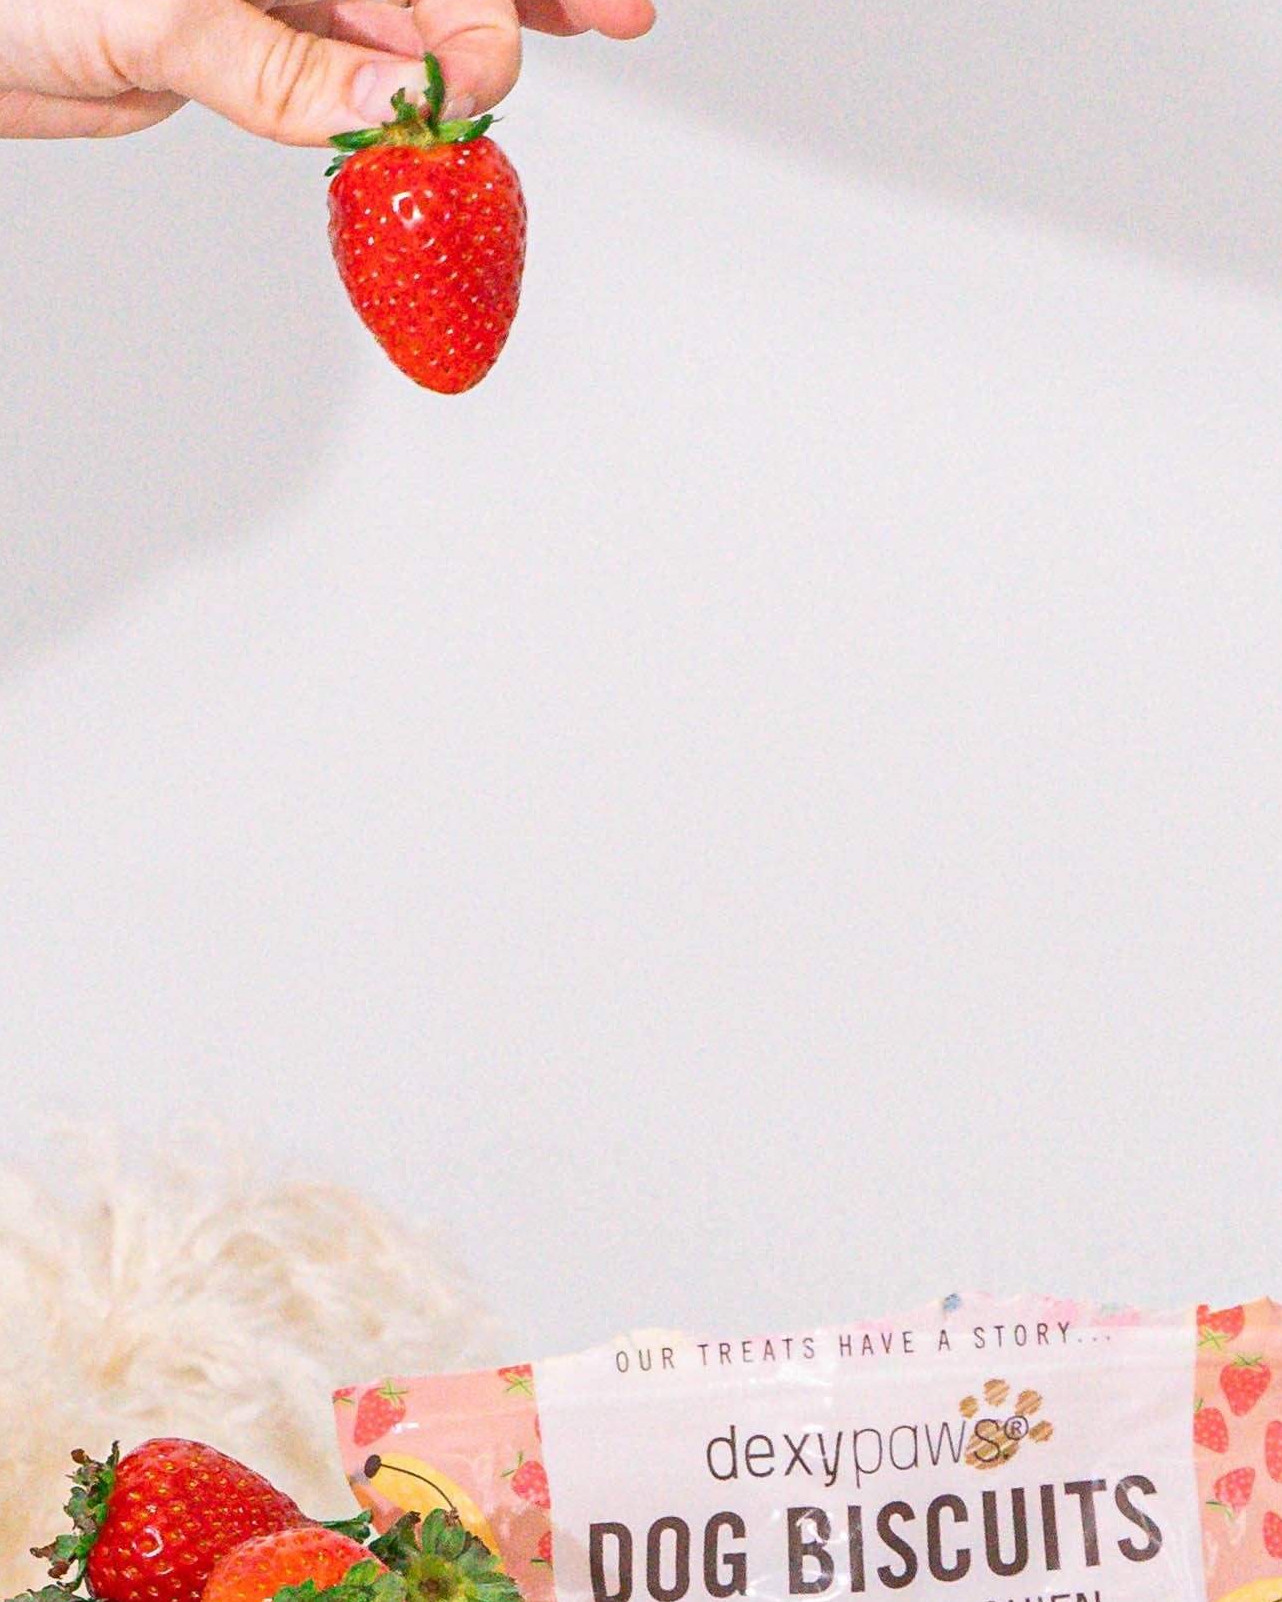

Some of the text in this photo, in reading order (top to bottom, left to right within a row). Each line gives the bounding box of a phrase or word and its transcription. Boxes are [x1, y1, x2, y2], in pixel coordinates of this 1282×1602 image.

[615, 1347, 675, 1373] OUR
[697, 1337, 815, 1366] TREATS
[839, 1330, 914, 1357] HAVE
[937, 1329, 951, 1351] A
[787, 1475, 1165, 1596] BISCUITS
